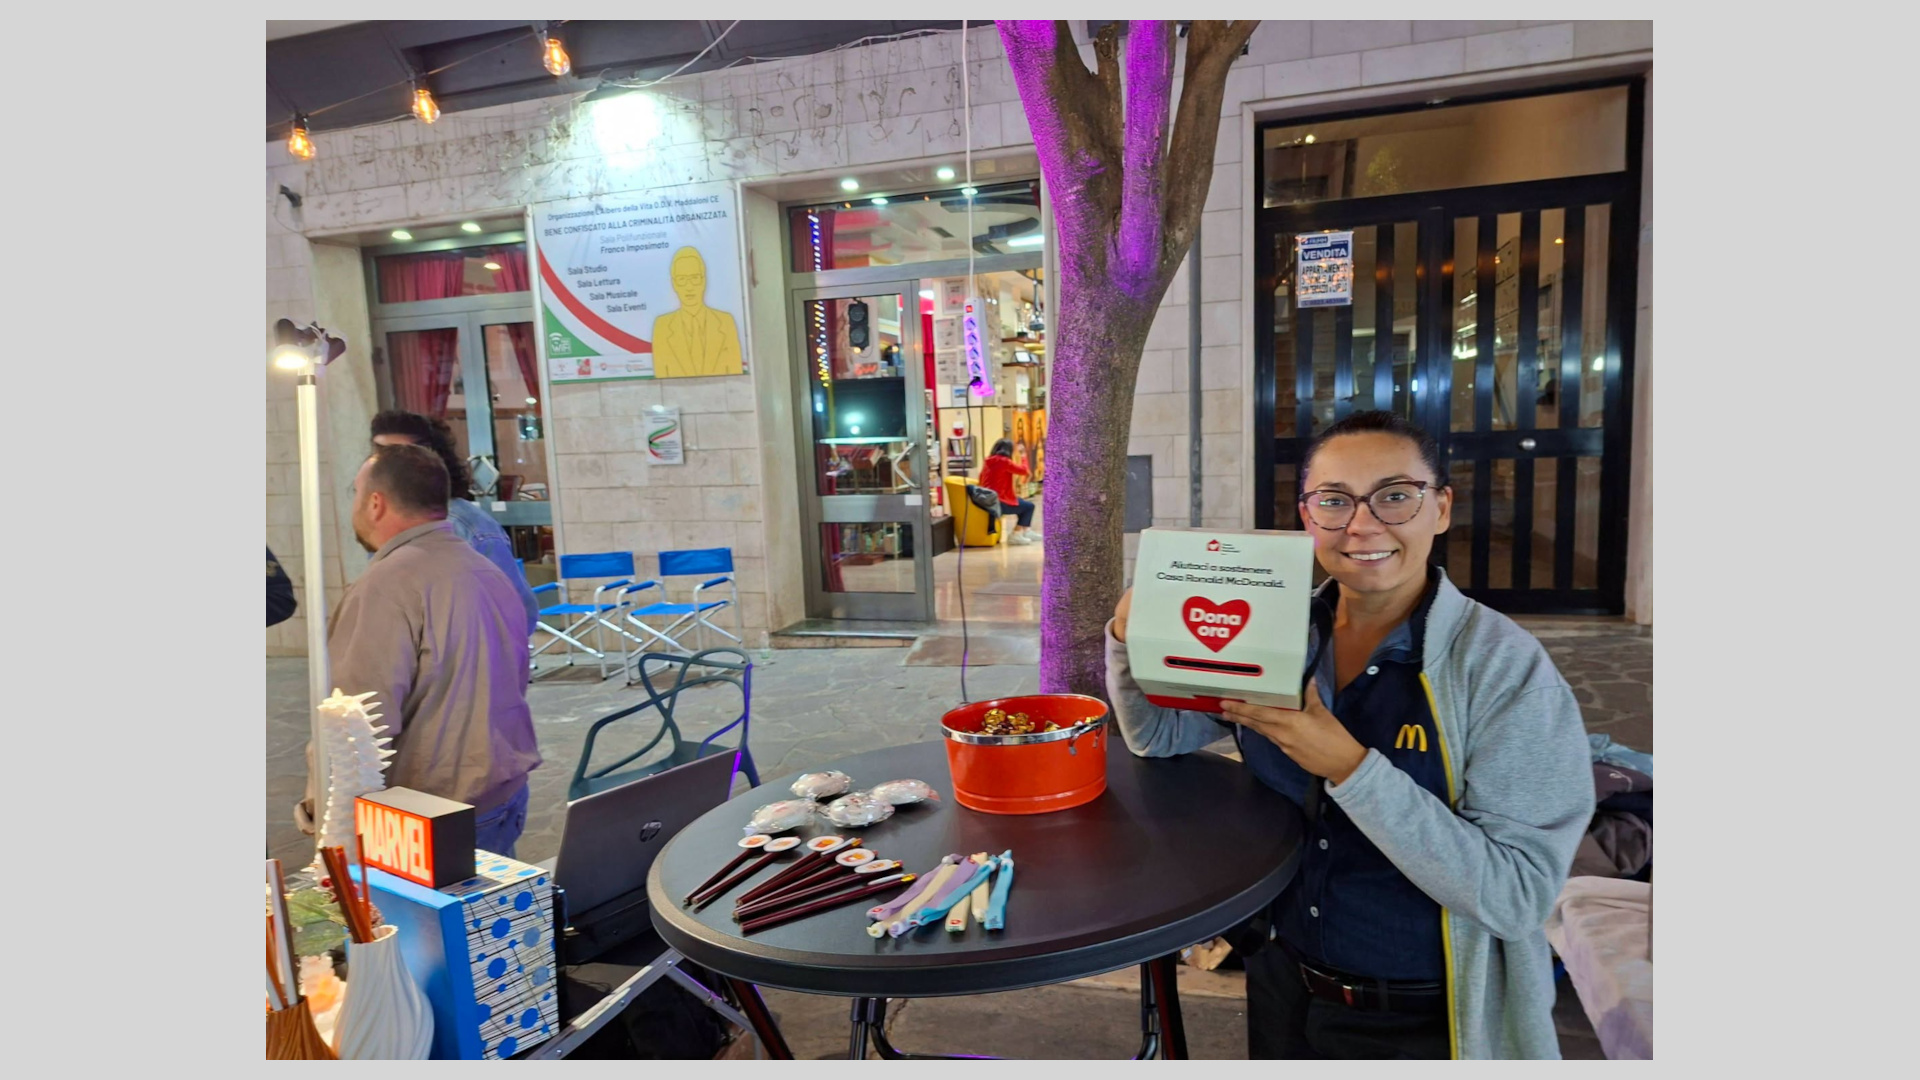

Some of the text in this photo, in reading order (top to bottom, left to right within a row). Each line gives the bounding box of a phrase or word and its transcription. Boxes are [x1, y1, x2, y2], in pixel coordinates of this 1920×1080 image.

[547, 210, 595, 221] Organizzazione
[622, 205, 639, 213] della
[640, 202, 653, 210] Vita
[675, 196, 709, 206] Maddaloni
[710, 194, 720, 203] CE
[544, 227, 563, 237] BENE
[563, 222, 607, 234] CONFISCATO
[607, 220, 628, 230] ALLA
[675, 210, 728, 223] ORGANIZZATA
[600, 241, 670, 255] Franco Imposimato
[1303, 248, 1347, 260] VENDITA
[568, 264, 608, 276] Sala Studio
[577, 278, 621, 289] Sala Lettura
[589, 290, 638, 301] Sala Musicale
[606, 302, 648, 313] Sala Eventi
[1170, 560, 1273, 574] Aiutaci a sostenere
[1156, 572, 1286, 589] Casa Ronald McDonald.
[1189, 607, 1242, 626] Dona
[1197, 625, 1230, 639] ora
[357, 801, 431, 882] MARVEL
